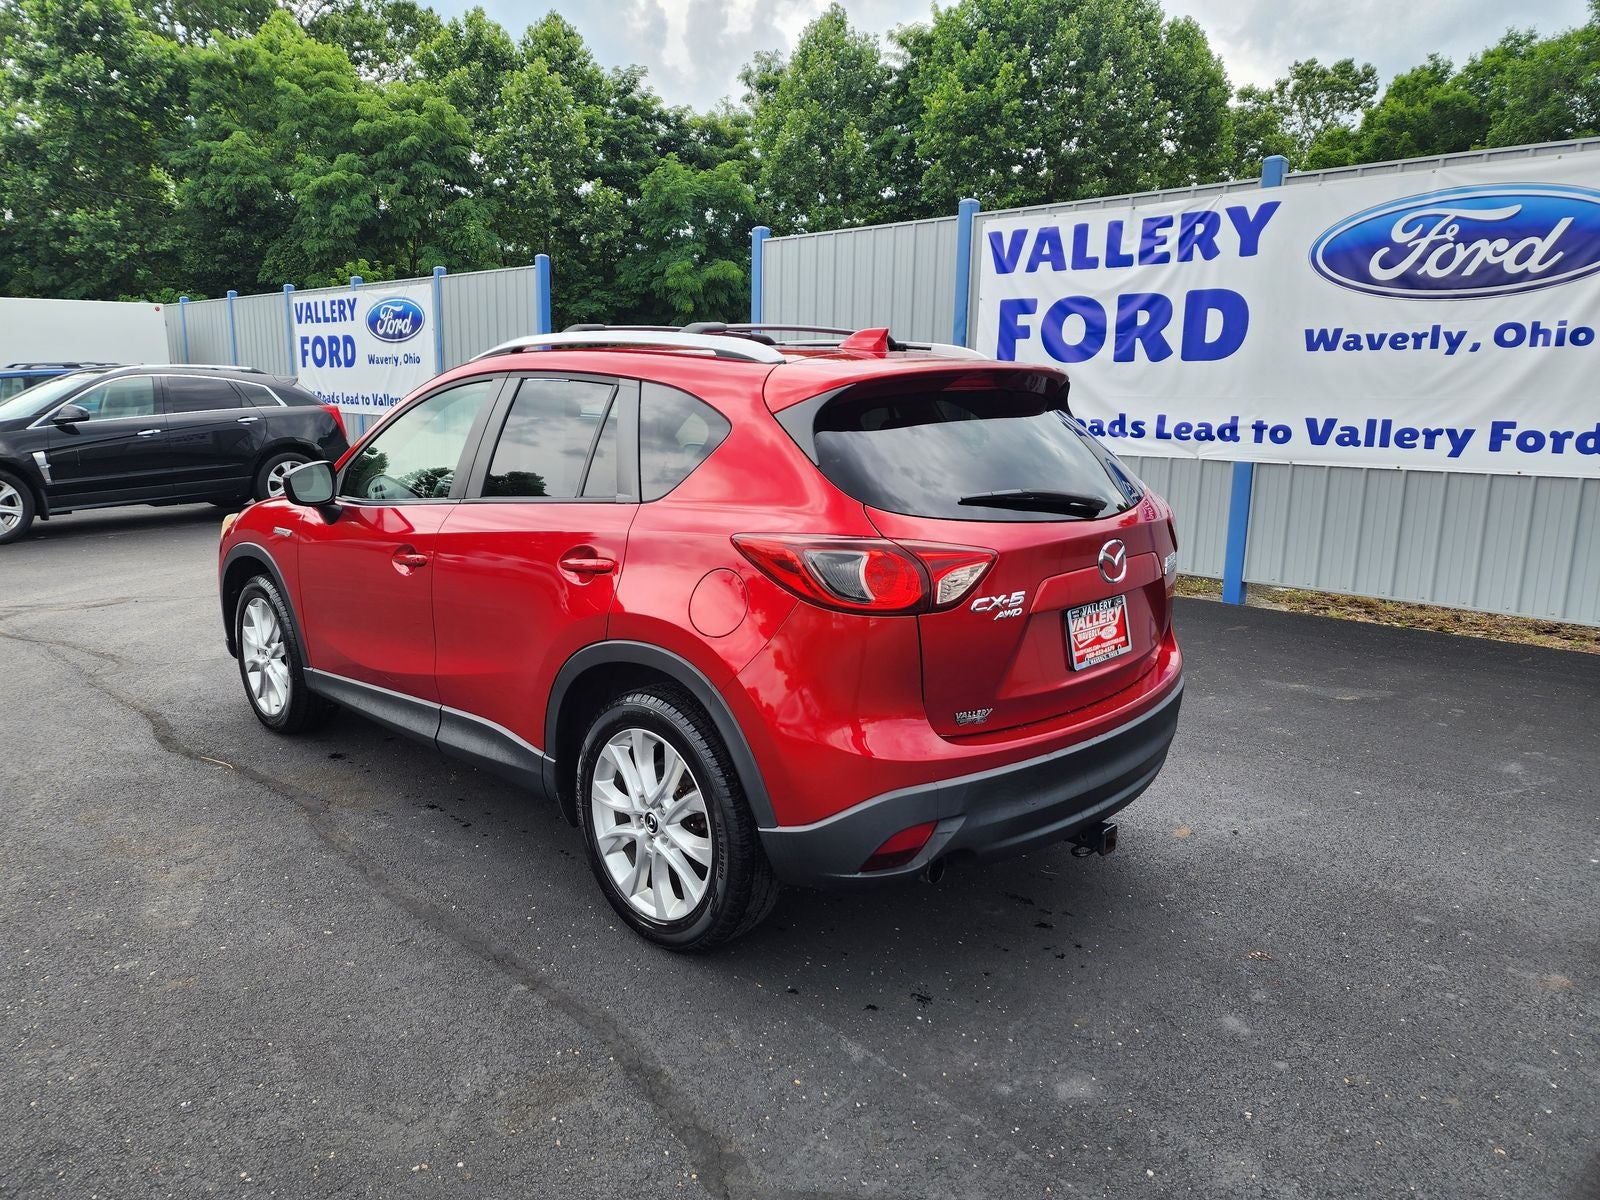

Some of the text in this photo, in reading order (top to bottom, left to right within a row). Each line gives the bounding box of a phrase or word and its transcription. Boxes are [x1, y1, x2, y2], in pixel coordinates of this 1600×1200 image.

[988, 200, 1281, 275] VALLERY
[1368, 203, 1575, 281] Ford
[294, 297, 357, 324] VALLERY
[376, 304, 413, 335] Ford
[996, 288, 1250, 364] FORD
[1304, 319, 1595, 357] Waverly, Ohio
[300, 334, 356, 368] FORD
[367, 353, 421, 367] Waverly, Ohio
[341, 392, 360, 406] Lead
[361, 394, 371, 406] to
[1075, 412, 1600, 459] ads Lead to Vallery Ford
[970, 590, 1026, 612] CX-5
[993, 607, 1023, 621] AWD
[1082, 599, 1112, 616] VALLERY
[1072, 605, 1122, 632] VALLERY
[955, 707, 993, 720] VALLERY
